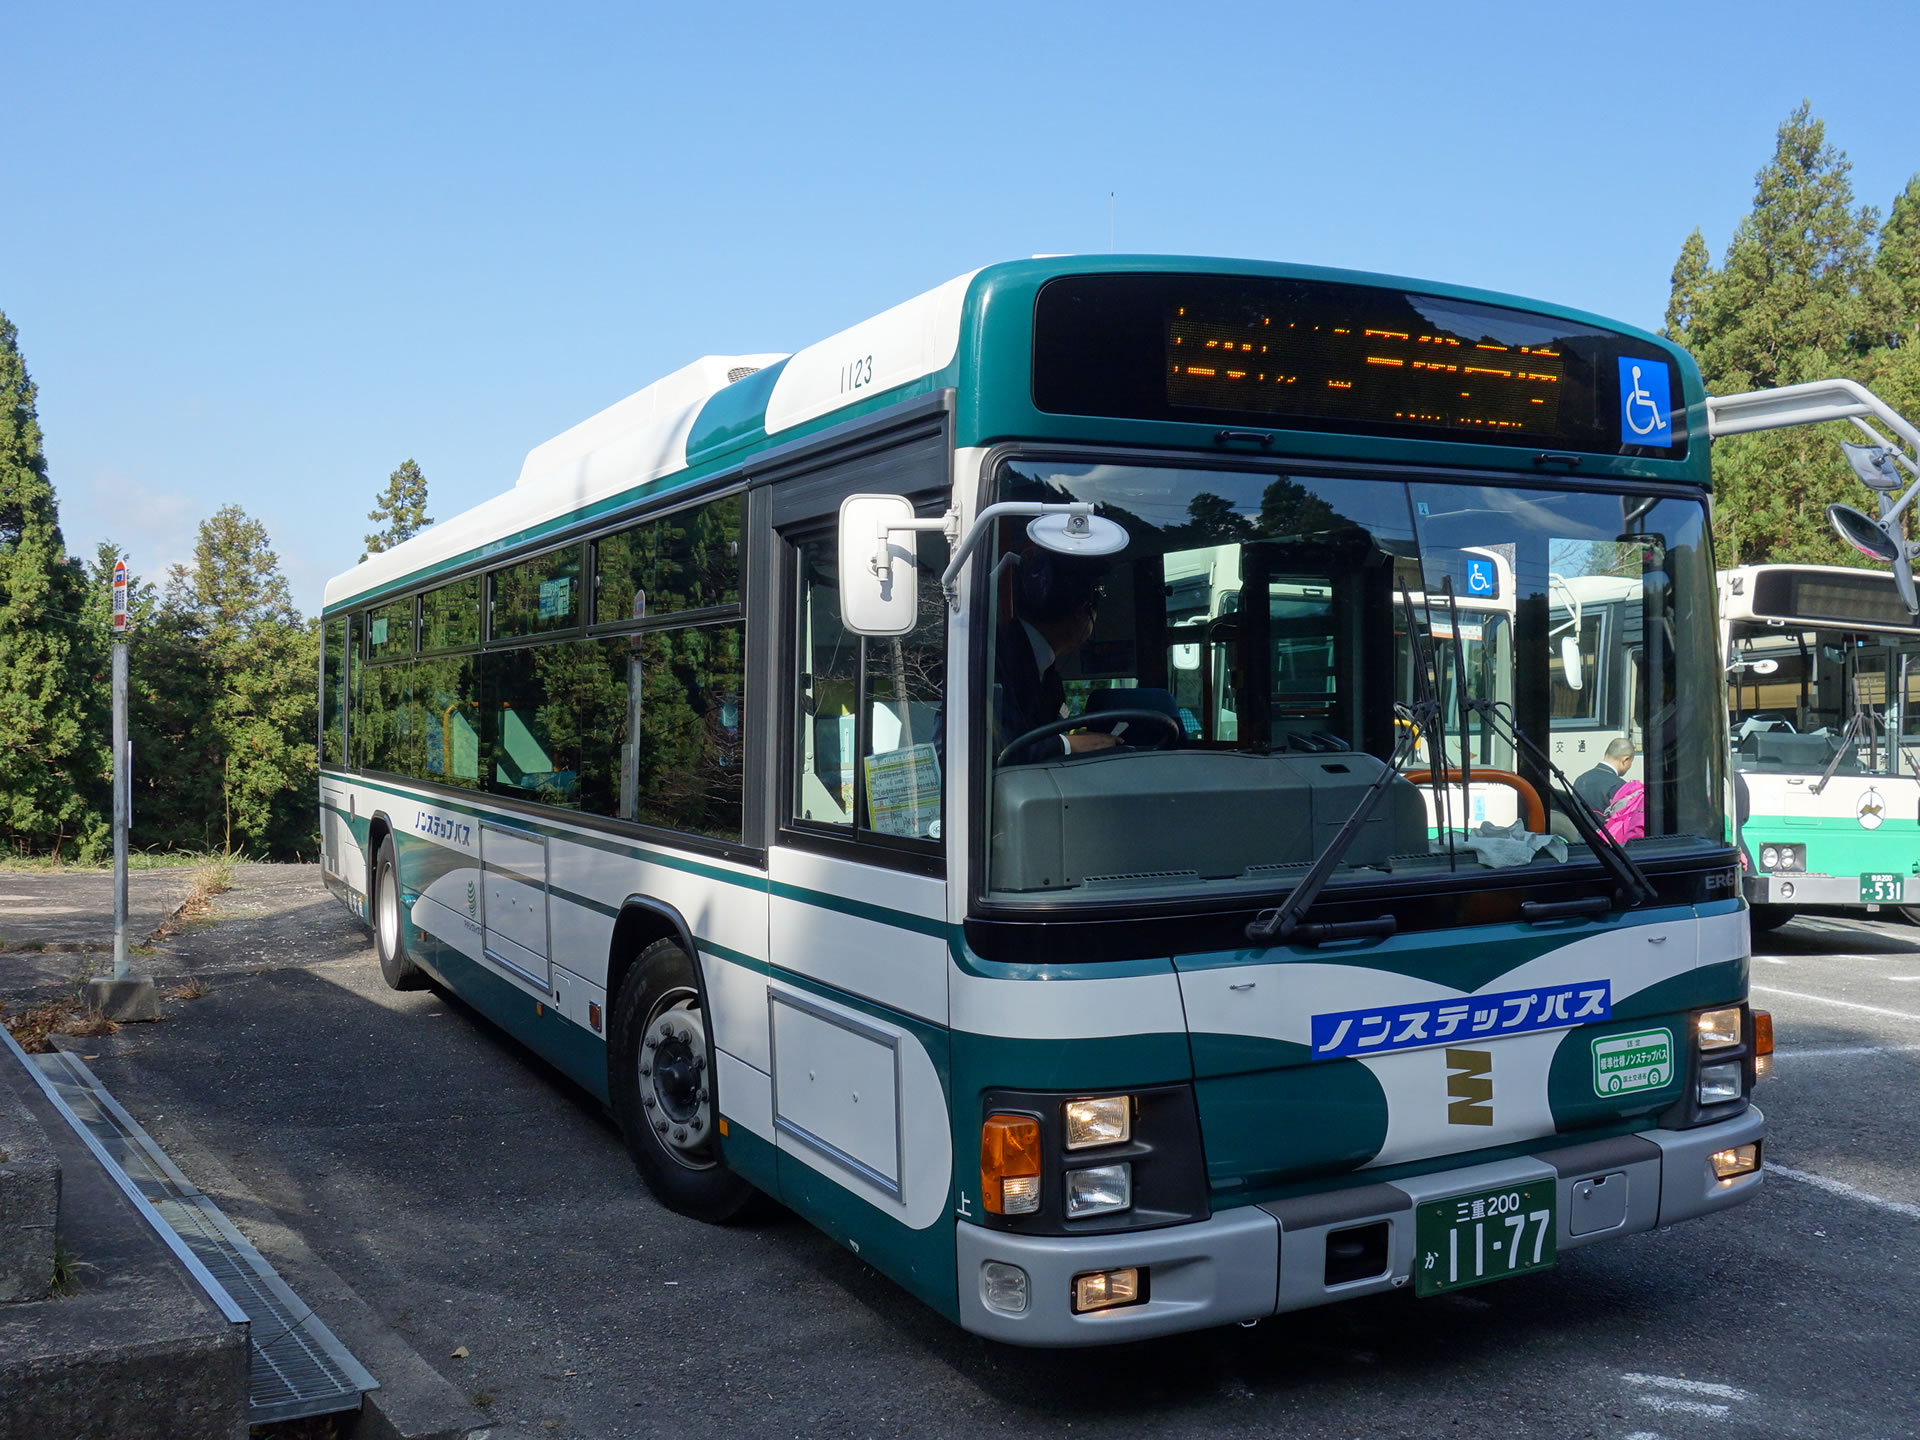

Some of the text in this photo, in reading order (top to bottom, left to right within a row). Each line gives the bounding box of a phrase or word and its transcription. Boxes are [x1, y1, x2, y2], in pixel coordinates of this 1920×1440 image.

[840, 354, 873, 394] 1123
[415, 811, 470, 847] ノンステップバス
[1318, 988, 1607, 1053] ノンステップバス
[956, 1190, 972, 1217] 上
